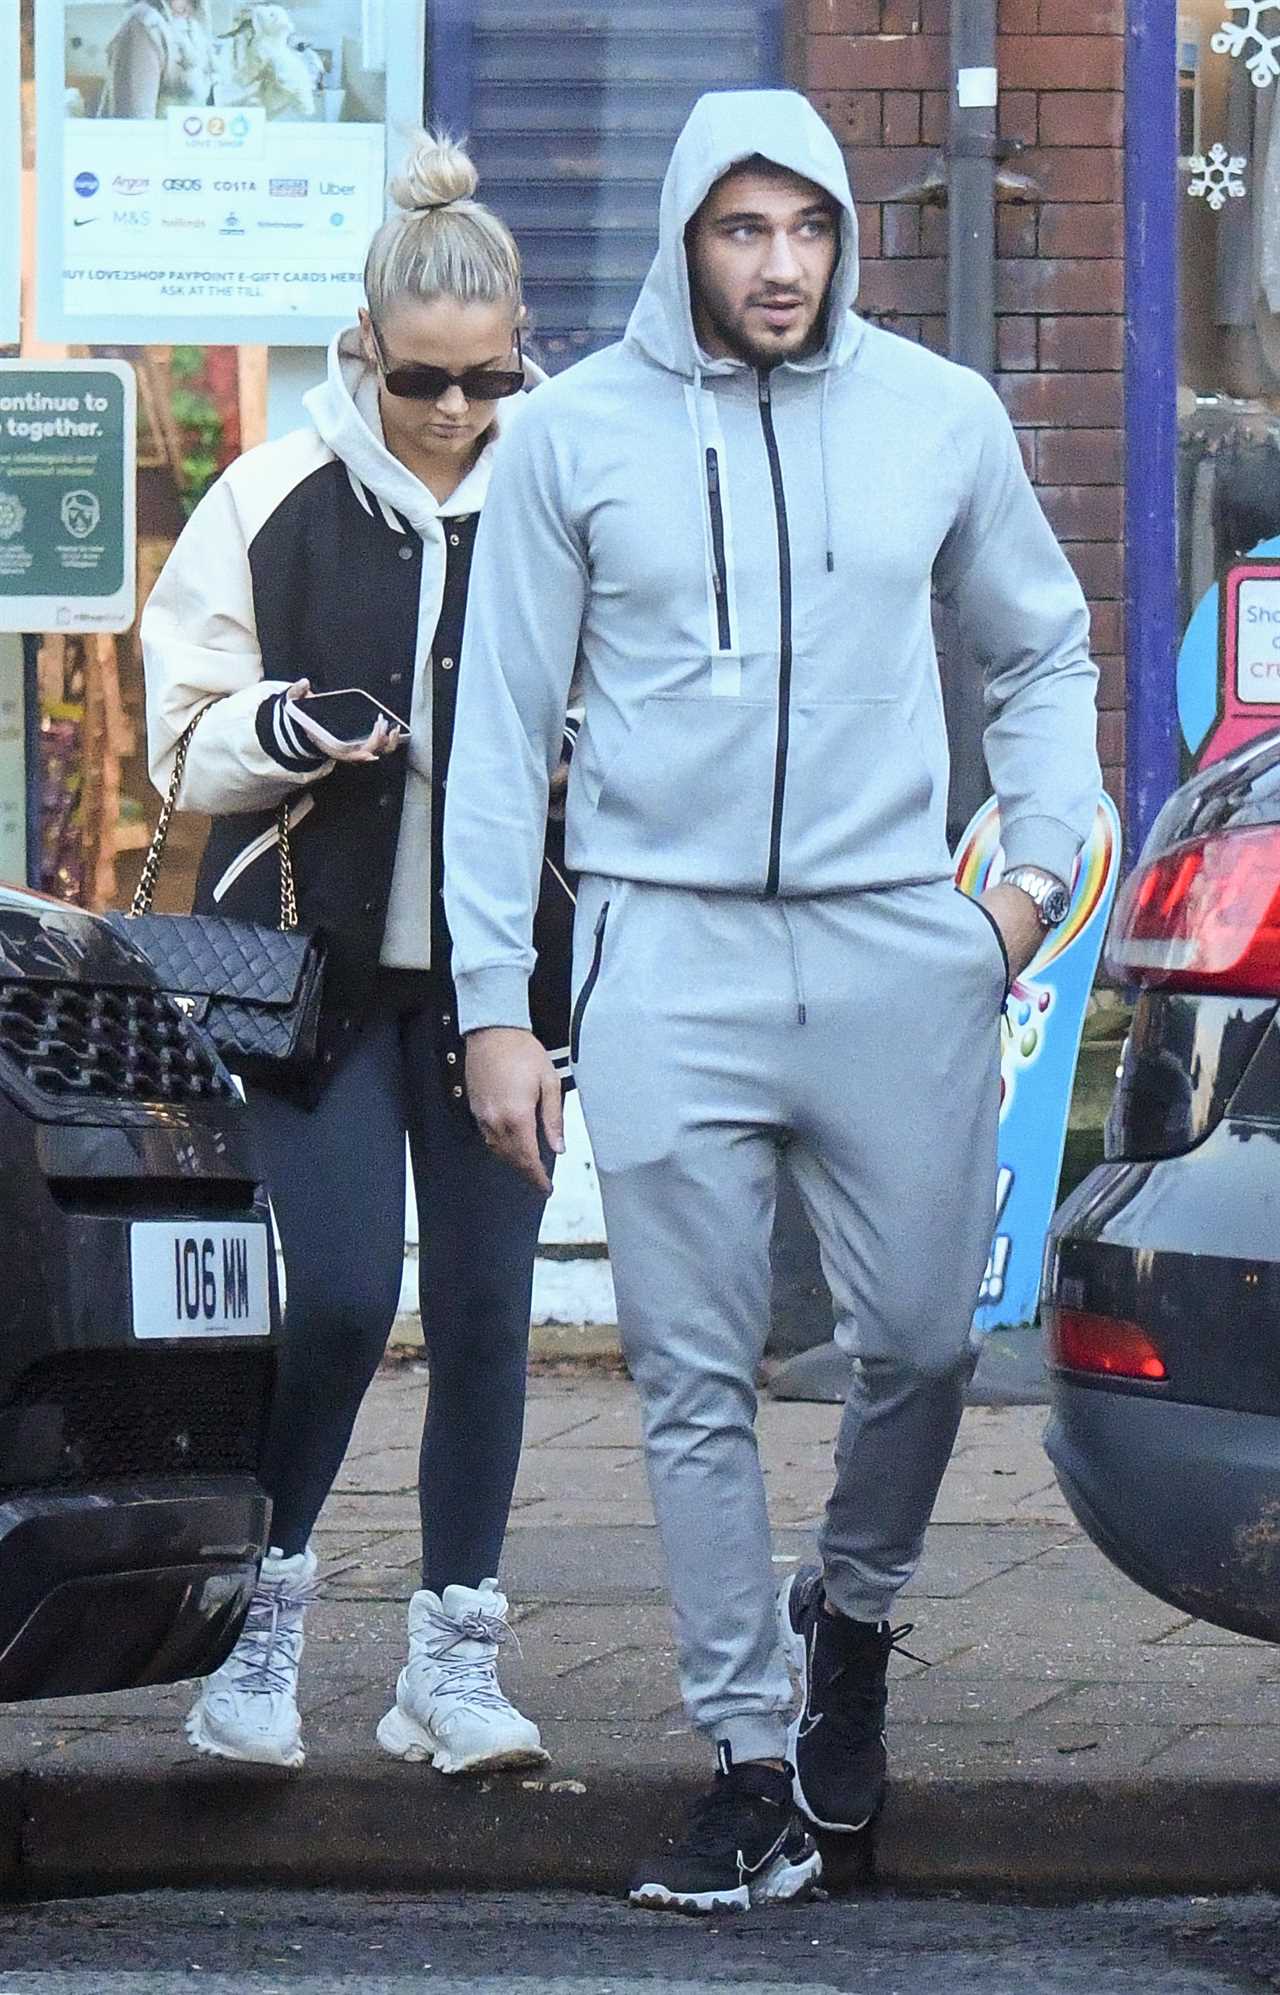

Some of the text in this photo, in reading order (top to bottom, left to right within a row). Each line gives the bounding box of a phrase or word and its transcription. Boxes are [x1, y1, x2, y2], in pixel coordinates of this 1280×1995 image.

[112, 175, 150, 191] Argos
[213, 181, 256, 191] COSTA
[319, 181, 355, 195] Uber
[112, 210, 152, 225] M&S
[88, 270, 165, 280] LOVE2SHOP
[168, 271, 234, 281] PAYPOINT
[237, 272, 280, 282] E-GIFT
[283, 272, 327, 282] CARDS
[161, 286, 185, 295] ASK
[189, 286, 205, 296] AT
[208, 286, 233, 296] THE
[85, 392, 109, 412] to
[8, 417, 103, 442] together.
